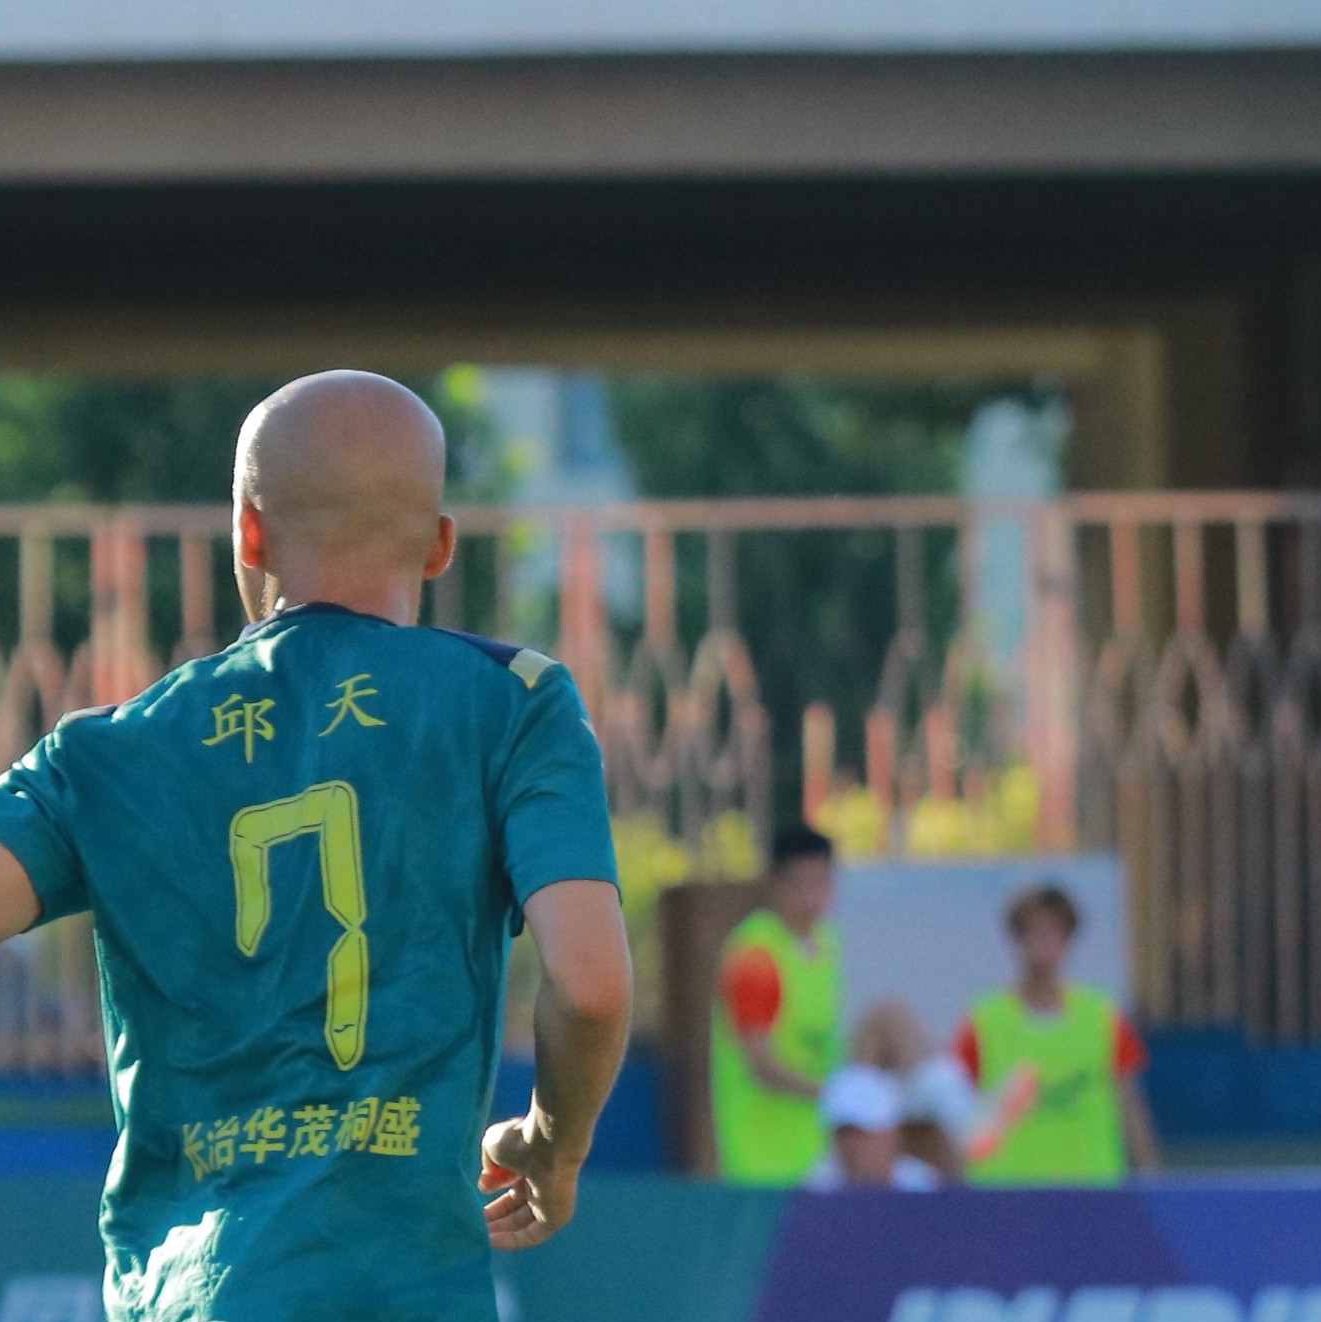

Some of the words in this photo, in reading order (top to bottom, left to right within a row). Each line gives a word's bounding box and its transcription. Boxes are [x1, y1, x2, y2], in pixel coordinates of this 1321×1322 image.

[202, 674, 386, 763] 邱天
[229, 780, 369, 1071] 7
[183, 1096, 421, 1181] 长治华茂桐盛
